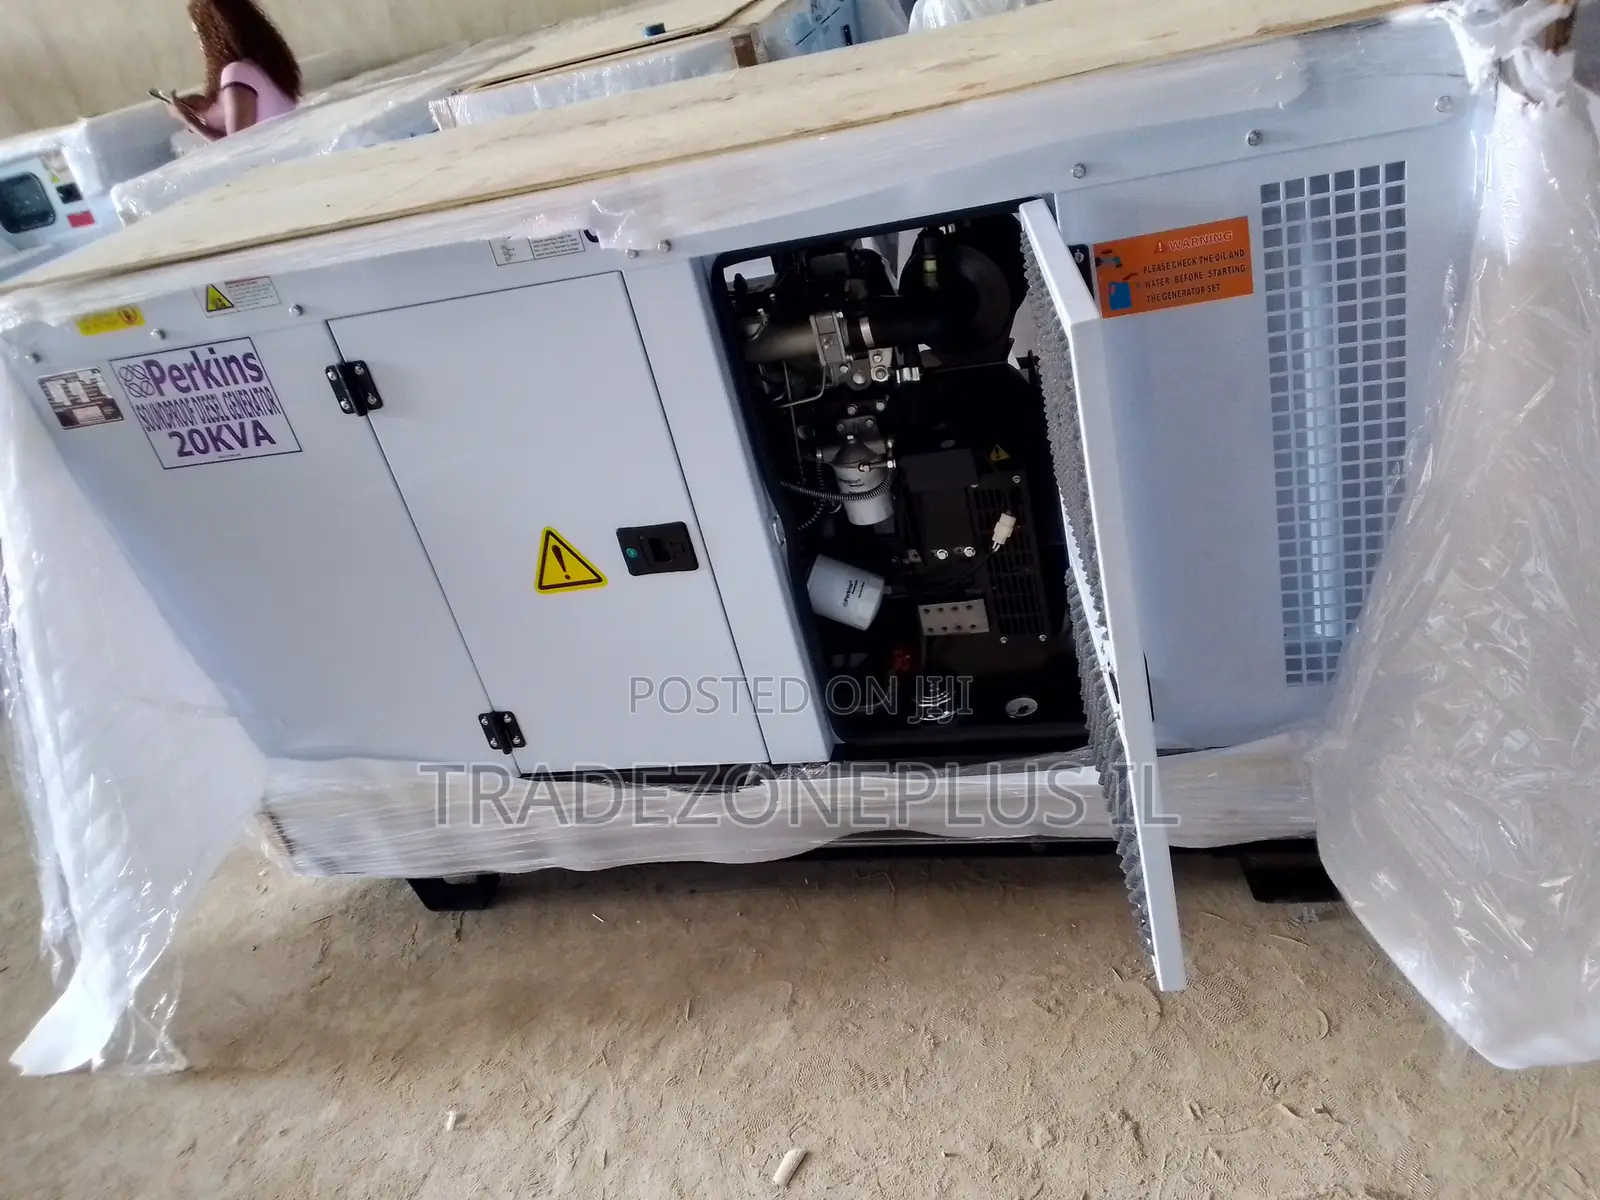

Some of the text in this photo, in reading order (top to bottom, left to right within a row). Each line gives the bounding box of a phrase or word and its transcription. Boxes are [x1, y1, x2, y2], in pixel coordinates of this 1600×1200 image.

[1168, 230, 1233, 251] WARNING
[1143, 249, 1245, 274] PLEASE CHECK THE OIL AND
[1145, 264, 1246, 289] WATER BEFORE STARTING
[1146, 293, 1161, 303] THE
[1162, 286, 1206, 300] GENERATOR
[142, 346, 264, 397] Perkins
[190, 393, 231, 425] DIESEL
[221, 385, 282, 421] GENERATOR
[167, 419, 277, 458] 20KVA
